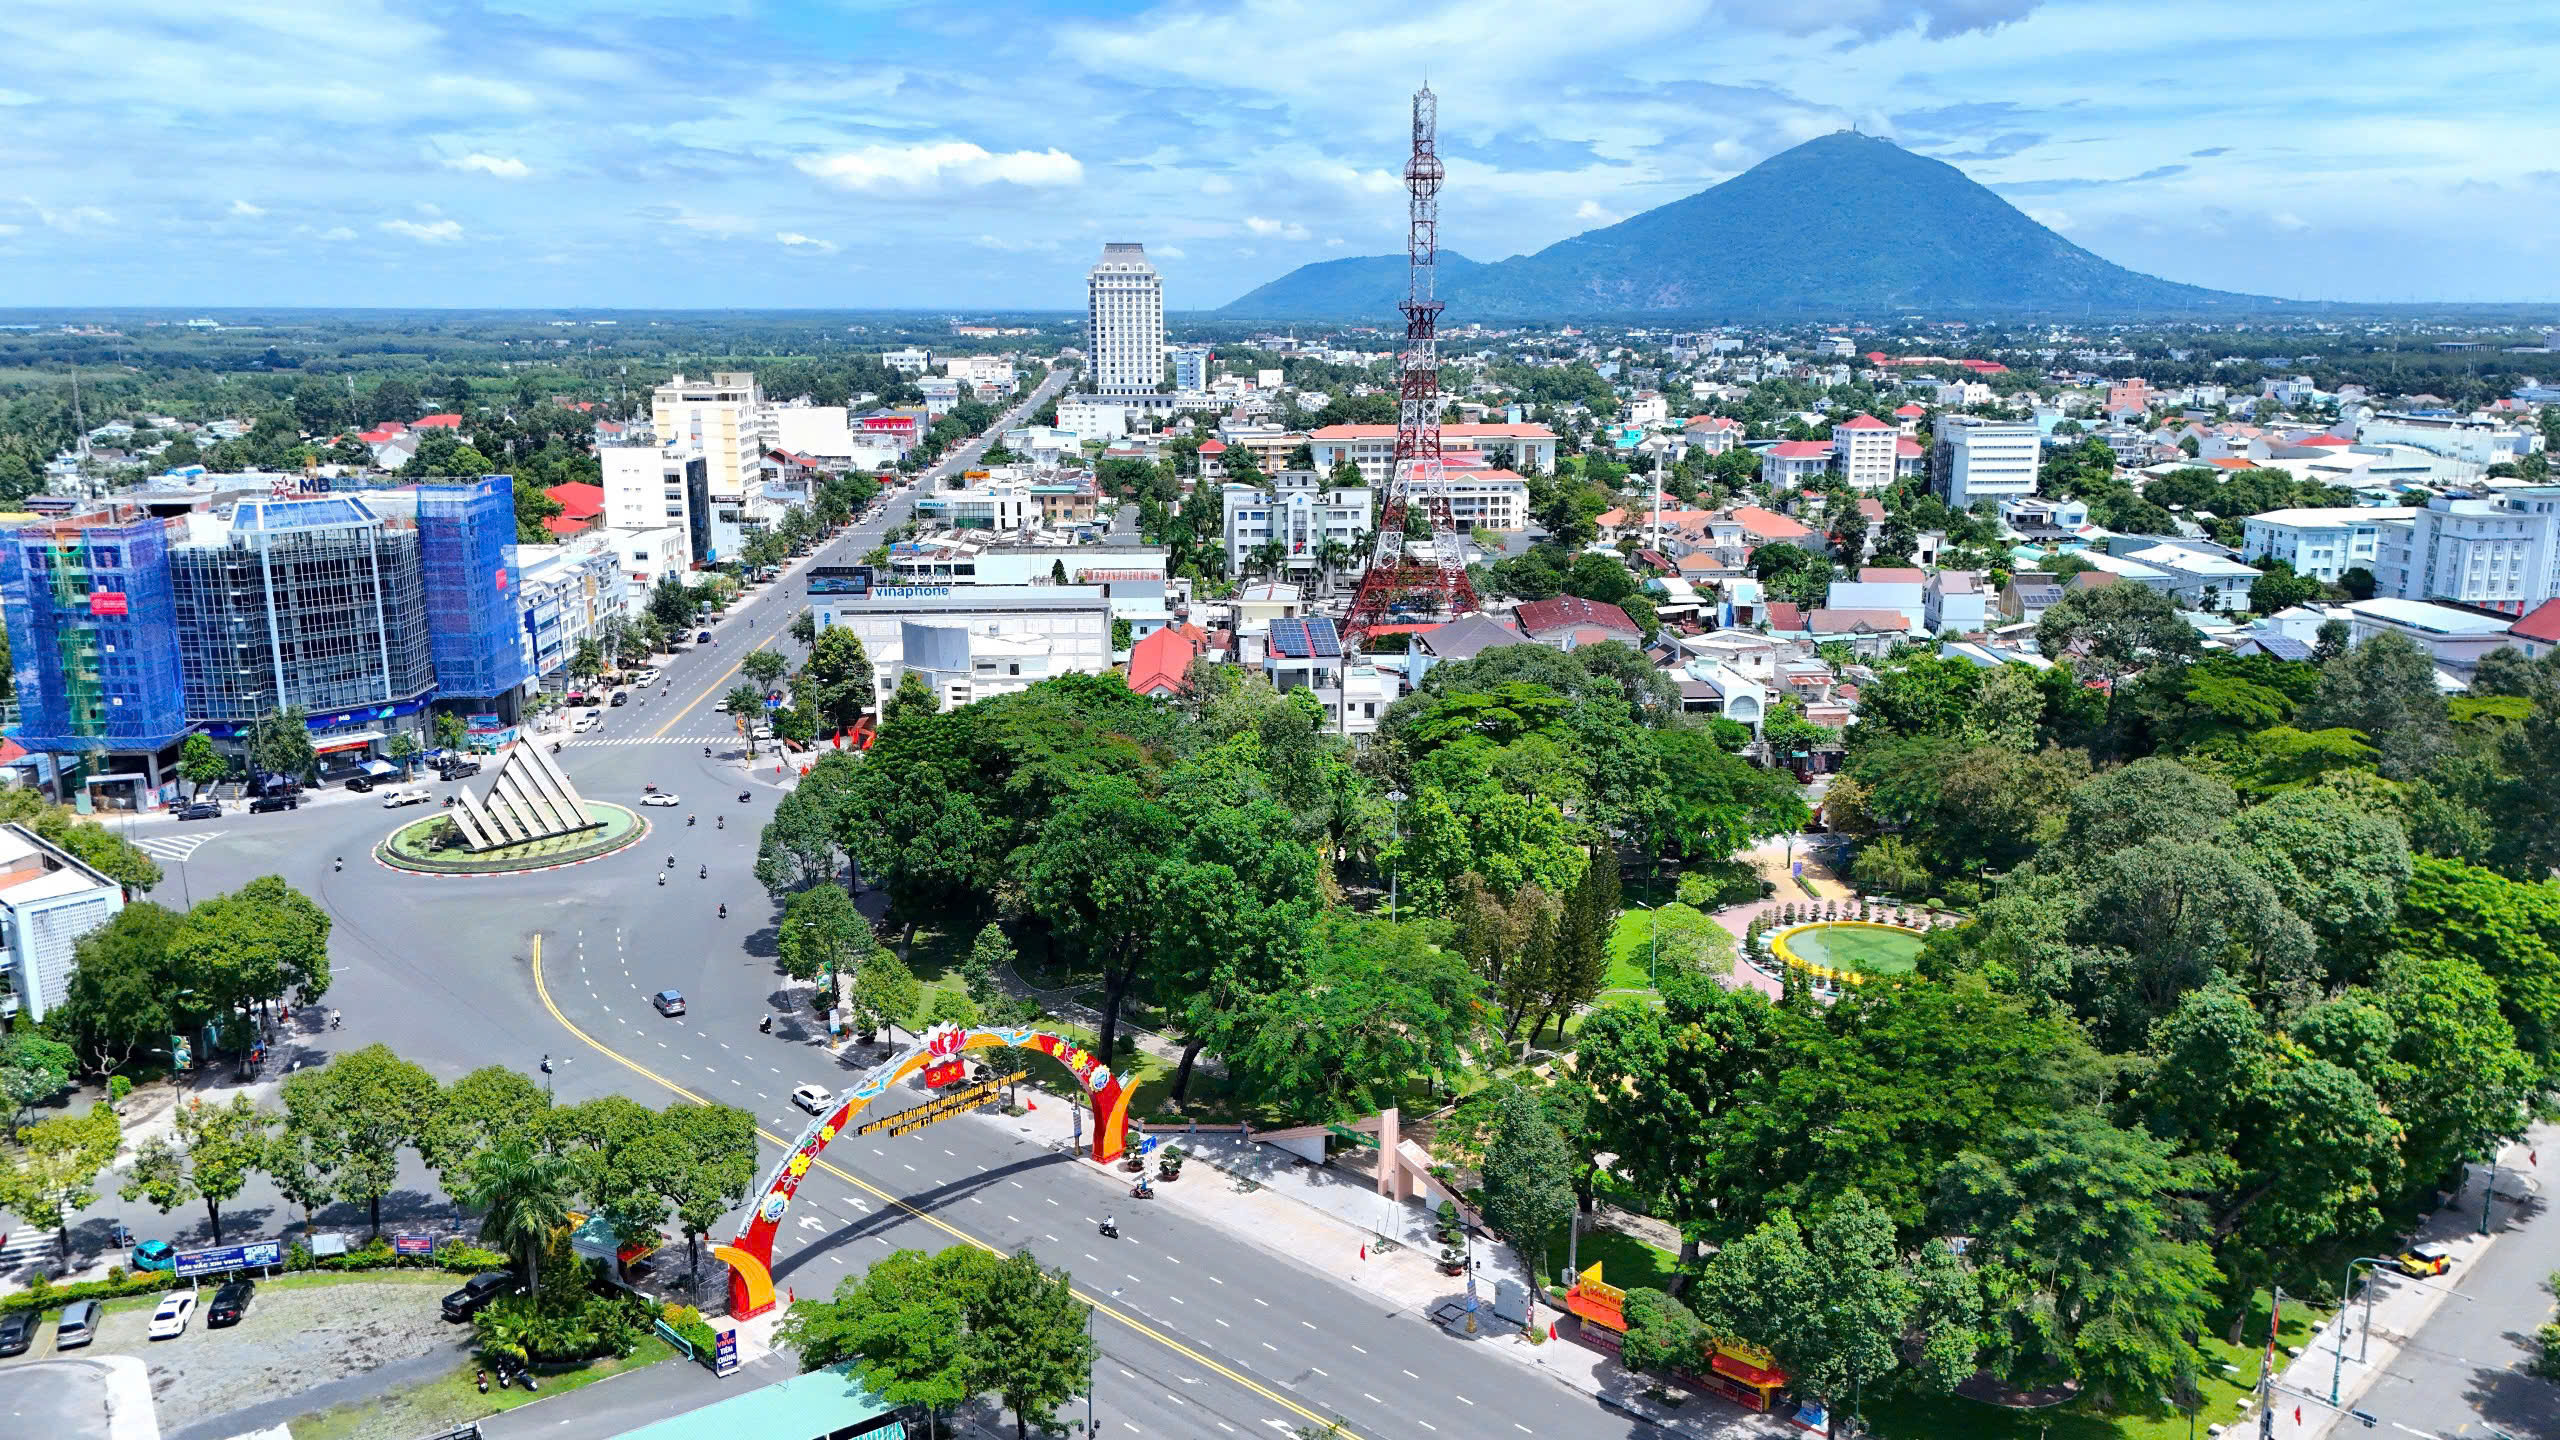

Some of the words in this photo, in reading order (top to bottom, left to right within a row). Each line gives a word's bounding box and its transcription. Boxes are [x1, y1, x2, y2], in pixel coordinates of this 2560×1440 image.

[299, 478, 331, 493] MB
[875, 586, 949, 598] vinaphone
[338, 714, 351, 722] MB
[963, 1099, 980, 1112] 2025
[983, 1092, 1000, 1105] 2030
[717, 1337, 736, 1348] VNVC
